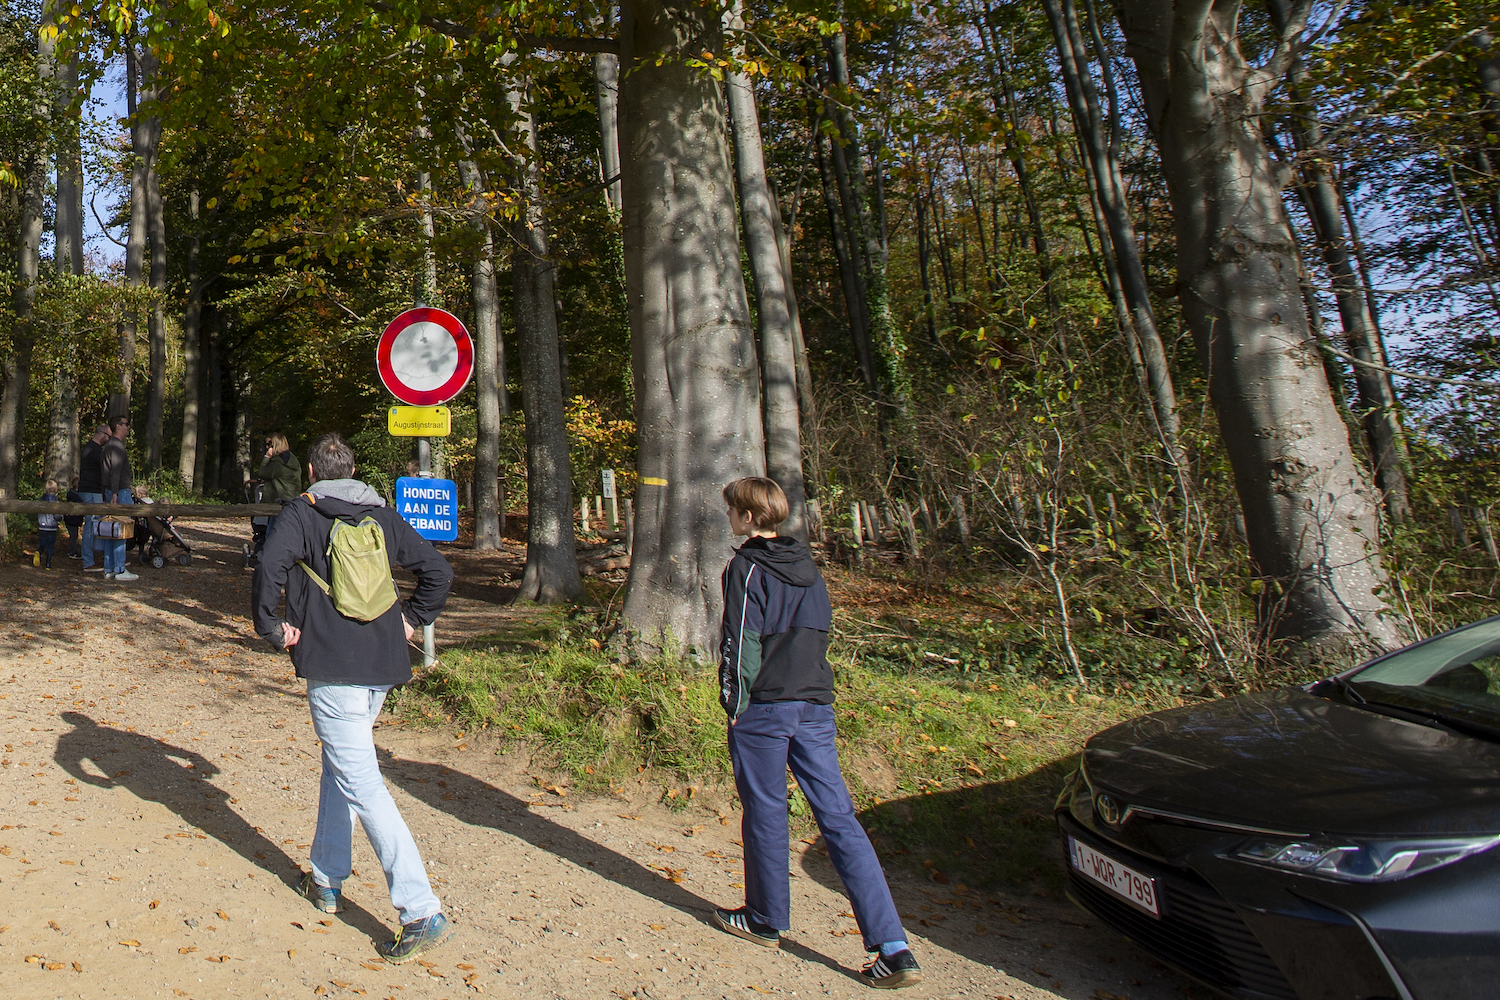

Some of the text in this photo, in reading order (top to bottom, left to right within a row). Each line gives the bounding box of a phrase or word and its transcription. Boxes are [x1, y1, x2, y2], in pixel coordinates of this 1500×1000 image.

[393, 421, 444, 430] Augustijnstraat
[403, 487, 450, 501] HONDEN
[404, 502, 451, 516] AAN DE
[403, 517, 452, 531] EIBAND
[1078, 846, 1153, 907] 1-WQR-799
